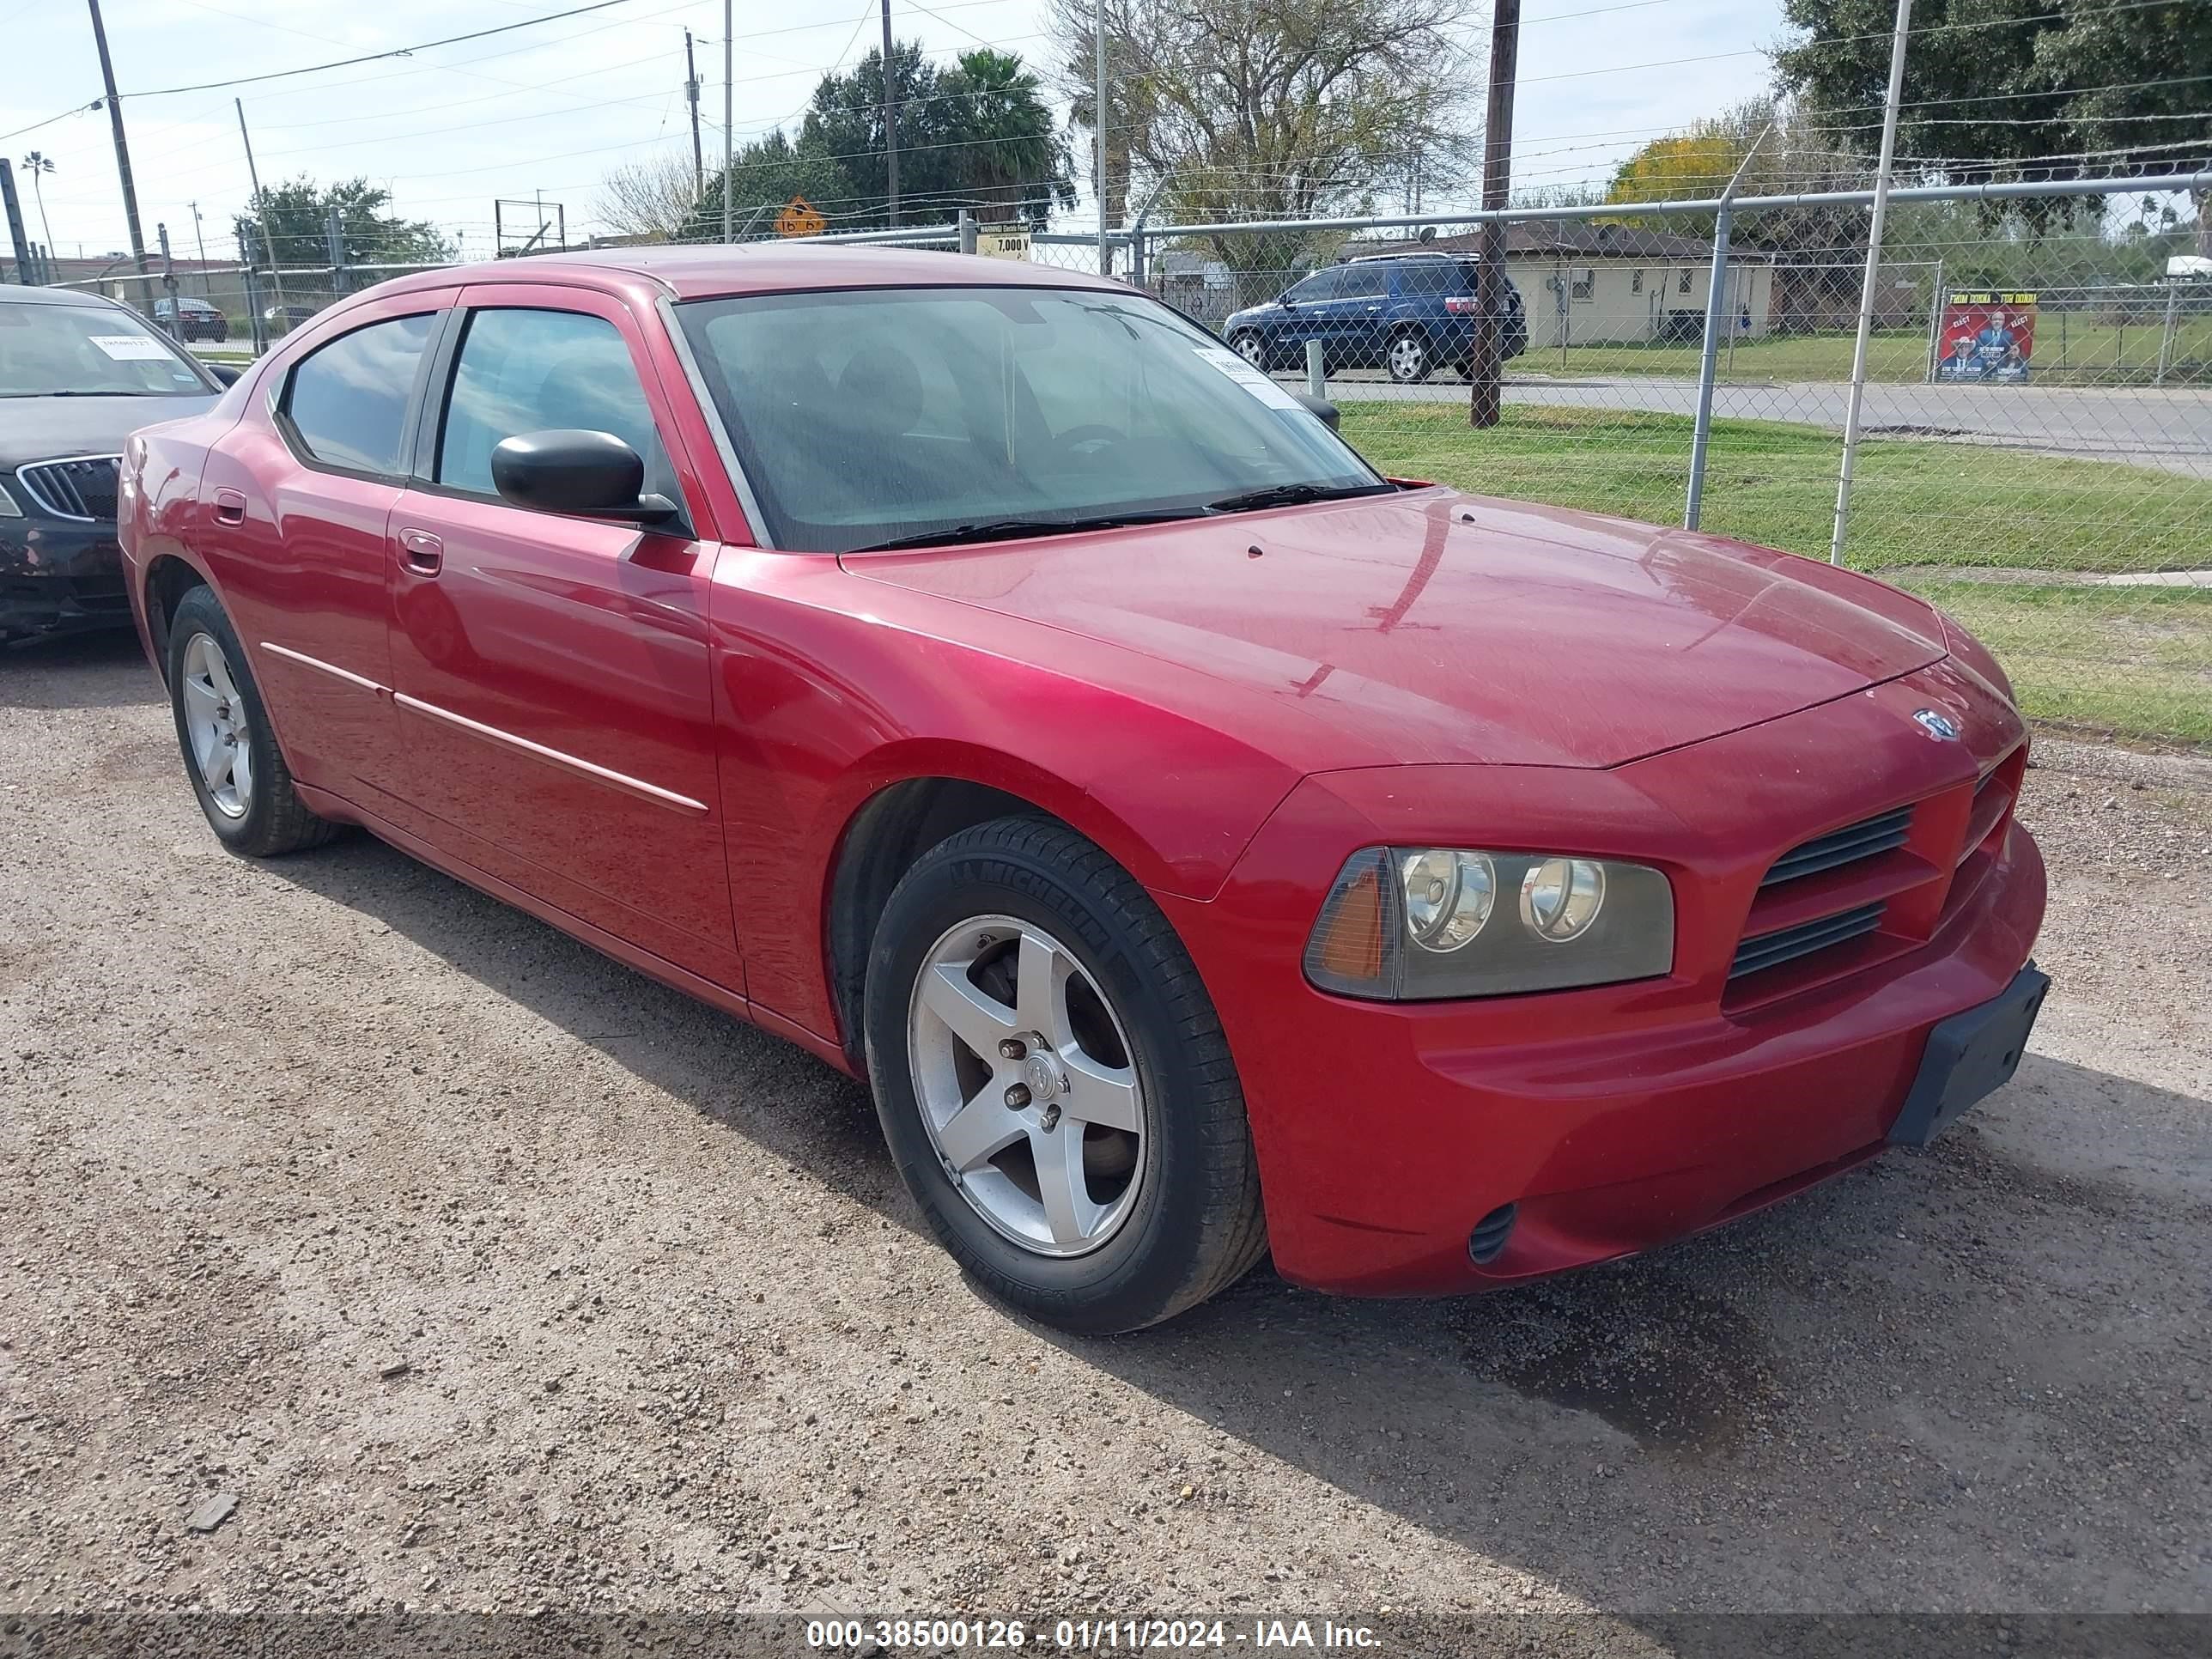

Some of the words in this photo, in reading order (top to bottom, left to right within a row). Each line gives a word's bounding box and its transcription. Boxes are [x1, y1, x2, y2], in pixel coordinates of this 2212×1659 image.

[998, 239, 1022, 253] 7,000
[1023, 239, 1030, 251] V
[2014, 293, 2037, 304] DONNA
[2011, 315, 2028, 328] ELECT
[980, 860, 1111, 954] MICHELIN
